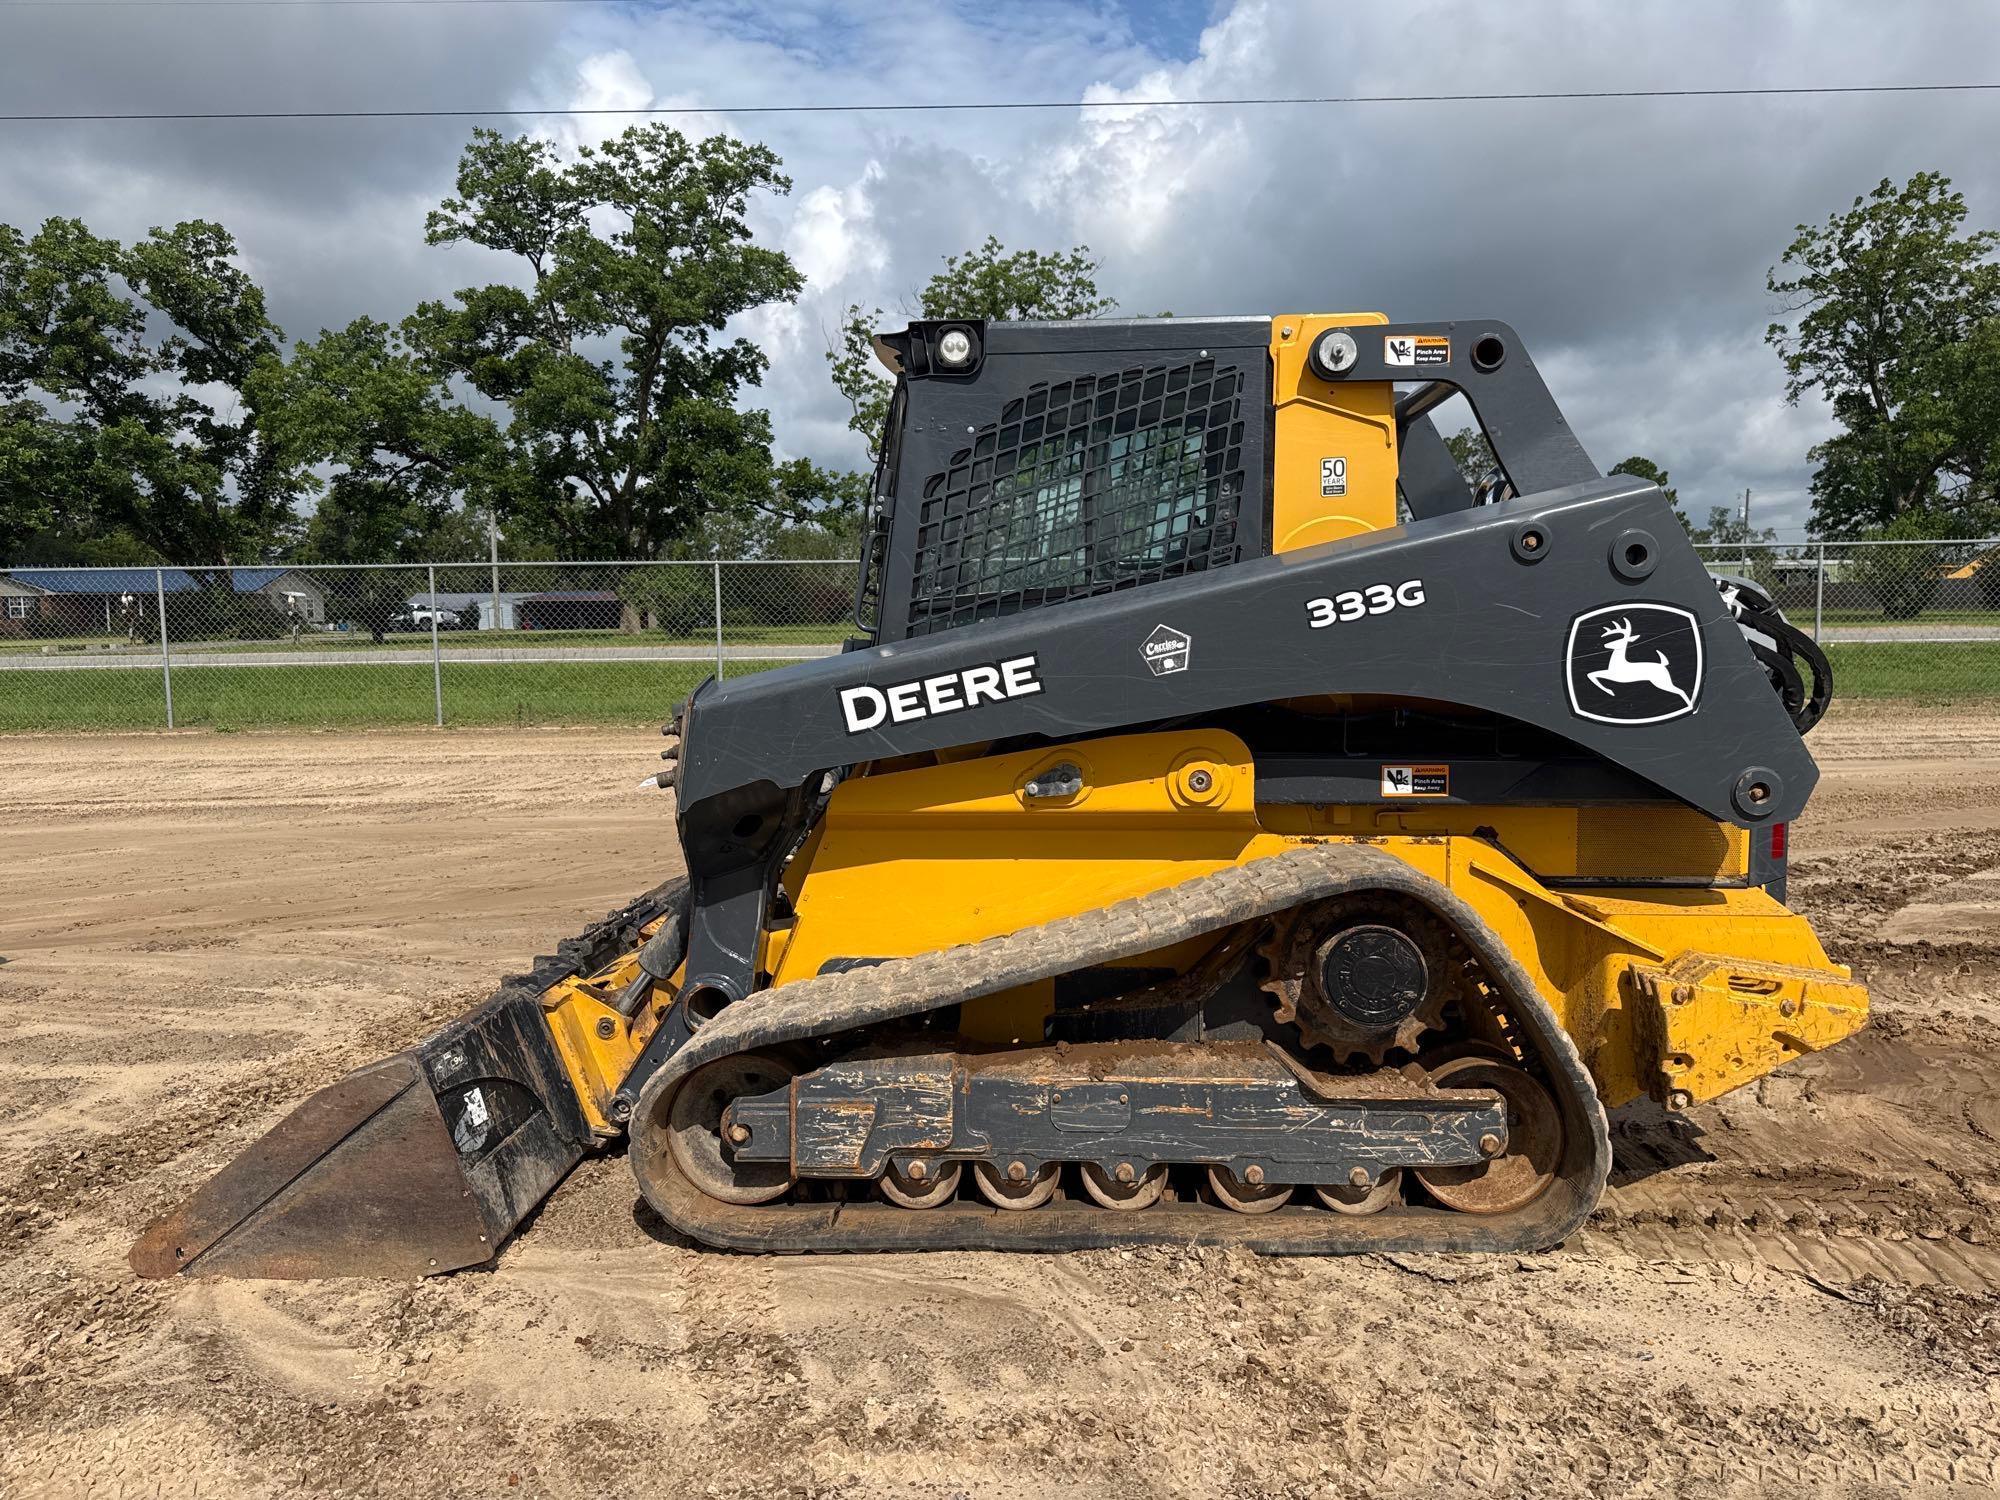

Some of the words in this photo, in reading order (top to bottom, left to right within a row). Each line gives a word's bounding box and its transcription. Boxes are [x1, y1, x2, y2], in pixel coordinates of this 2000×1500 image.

[1323, 459, 1345, 478] 50
[1323, 477, 1345, 485] YEARS
[1306, 580, 1426, 628] 333G
[840, 656, 1041, 733] DEERE
